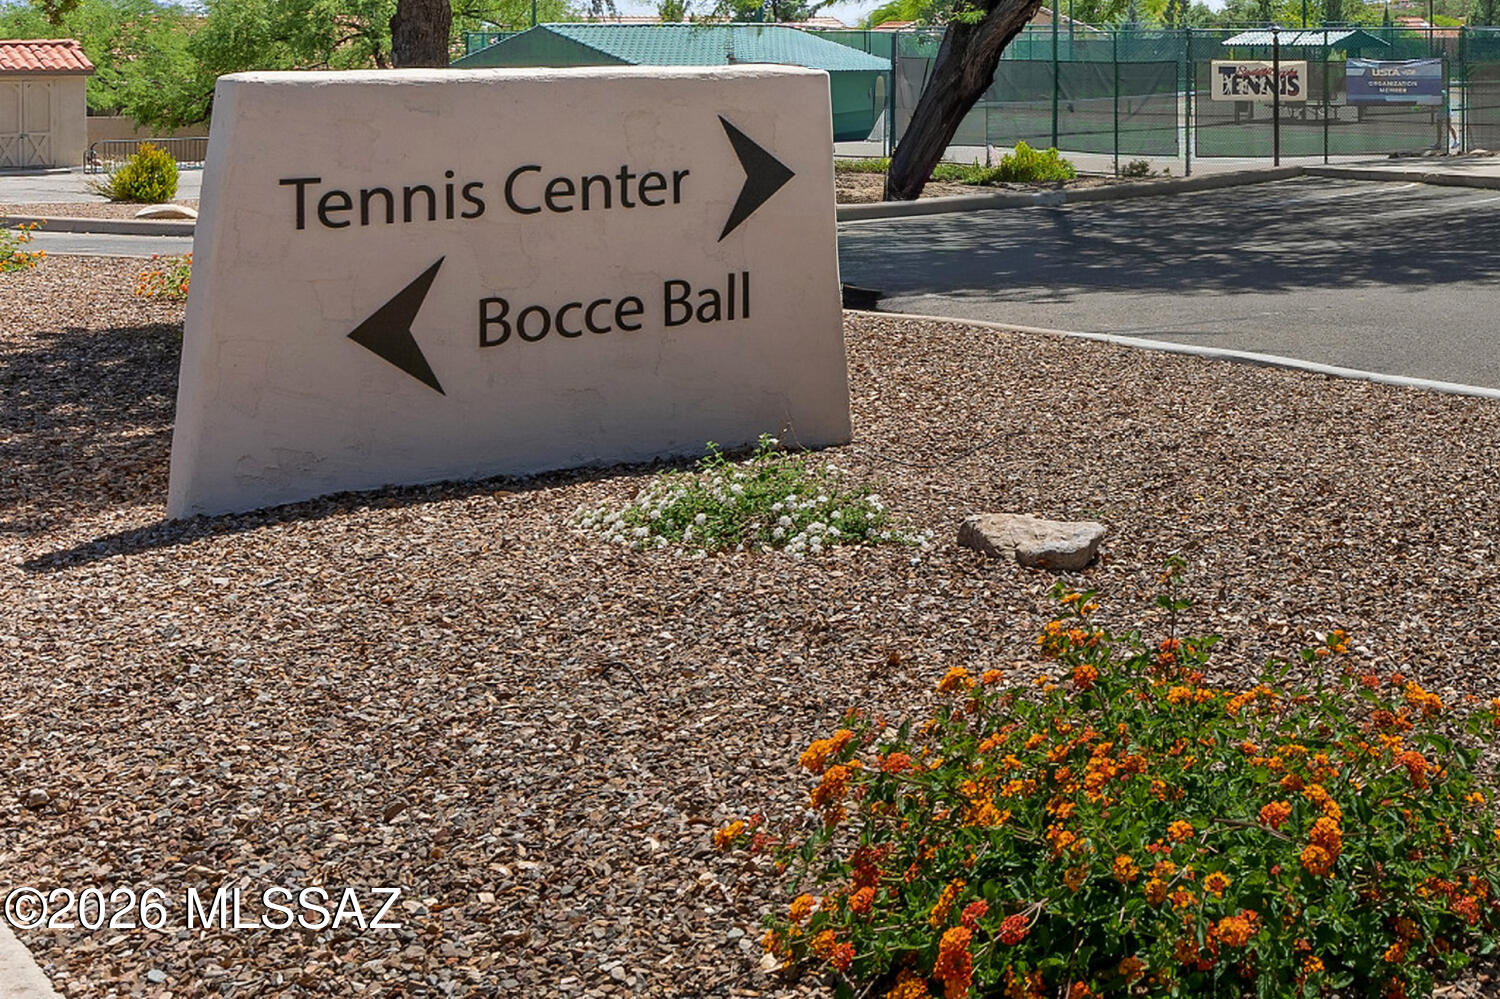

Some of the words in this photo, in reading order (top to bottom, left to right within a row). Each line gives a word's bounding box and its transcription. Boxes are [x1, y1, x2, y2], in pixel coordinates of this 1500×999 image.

[1218, 66, 1300, 96] TENNIS
[1371, 68, 1400, 77] USTA
[279, 170, 485, 230] Tennis
[504, 165, 690, 215] Center
[479, 296, 645, 348] Bocce
[664, 271, 750, 327] Ball
